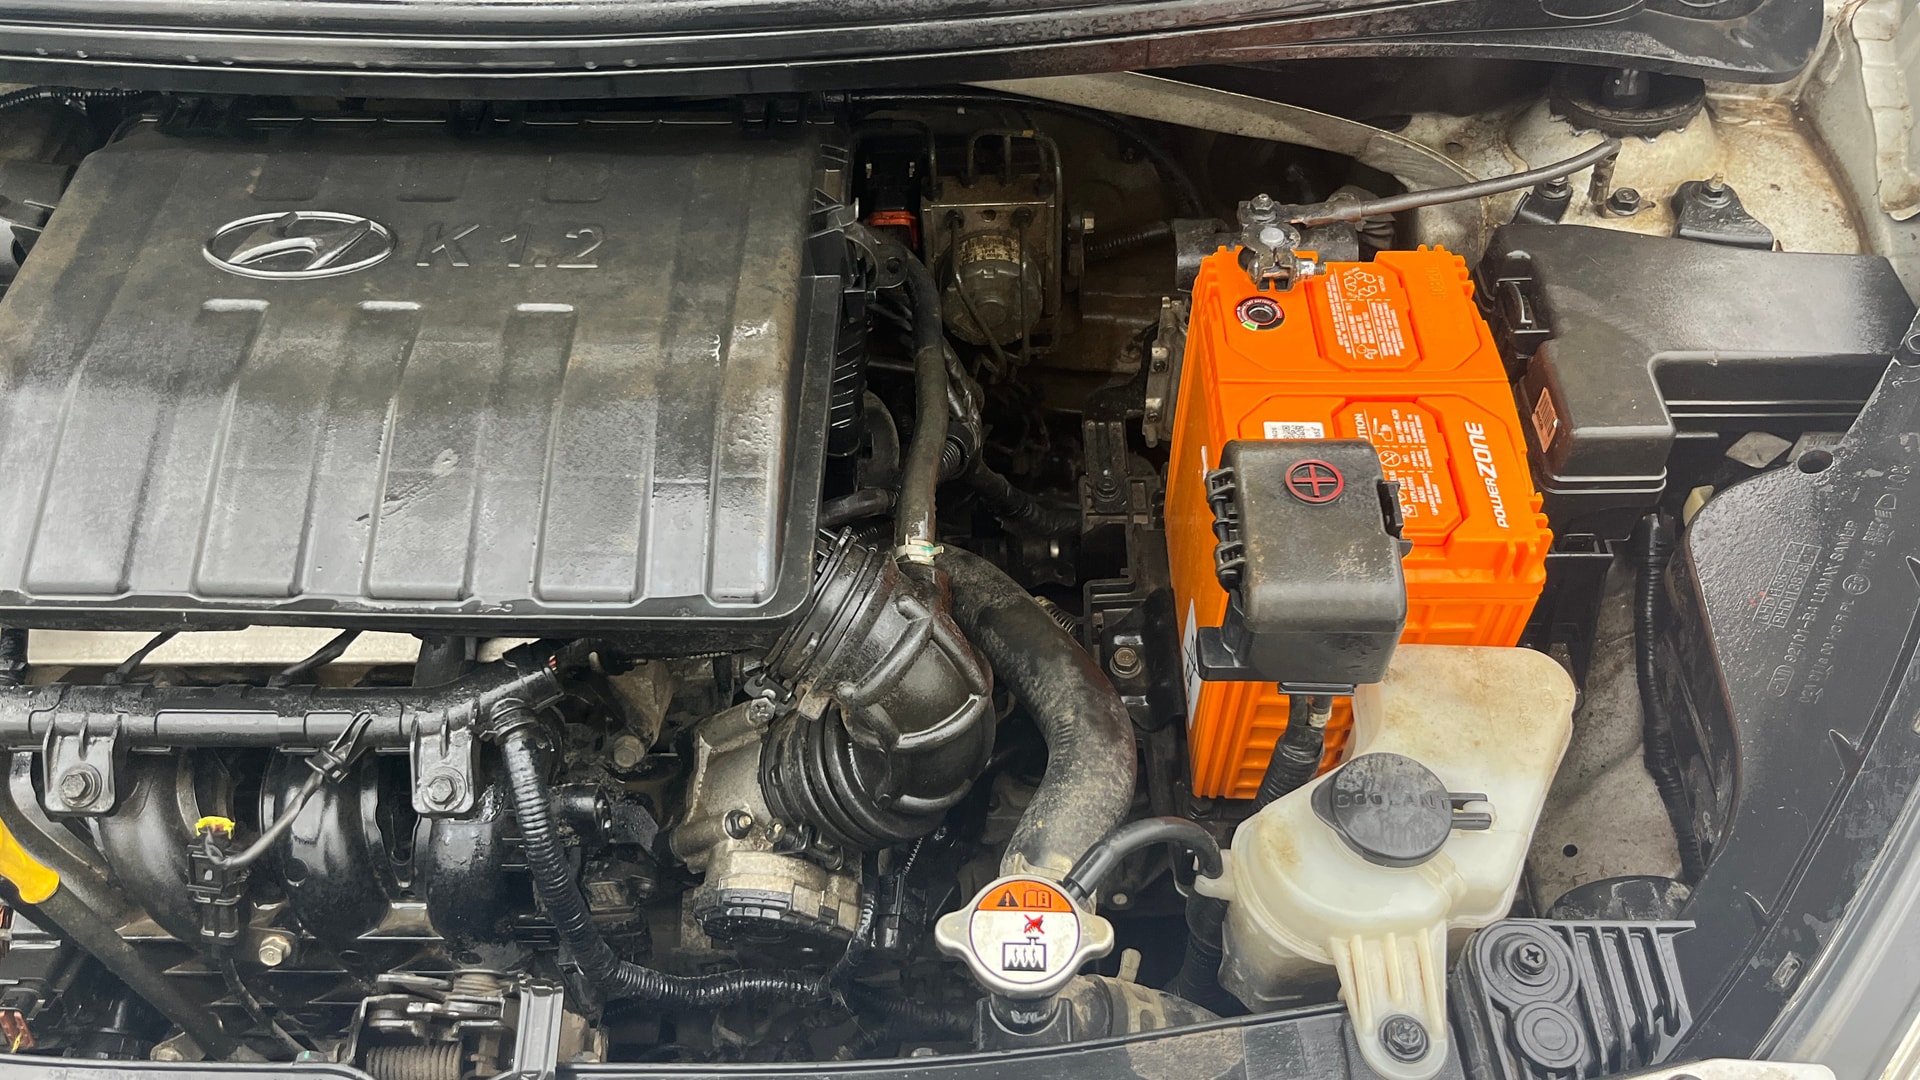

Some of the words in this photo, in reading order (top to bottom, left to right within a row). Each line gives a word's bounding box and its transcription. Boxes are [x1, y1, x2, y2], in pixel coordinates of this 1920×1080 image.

[416, 223, 480, 266] K
[500, 222, 605, 268] 1.2
[1336, 790, 1450, 811] COOLANT
